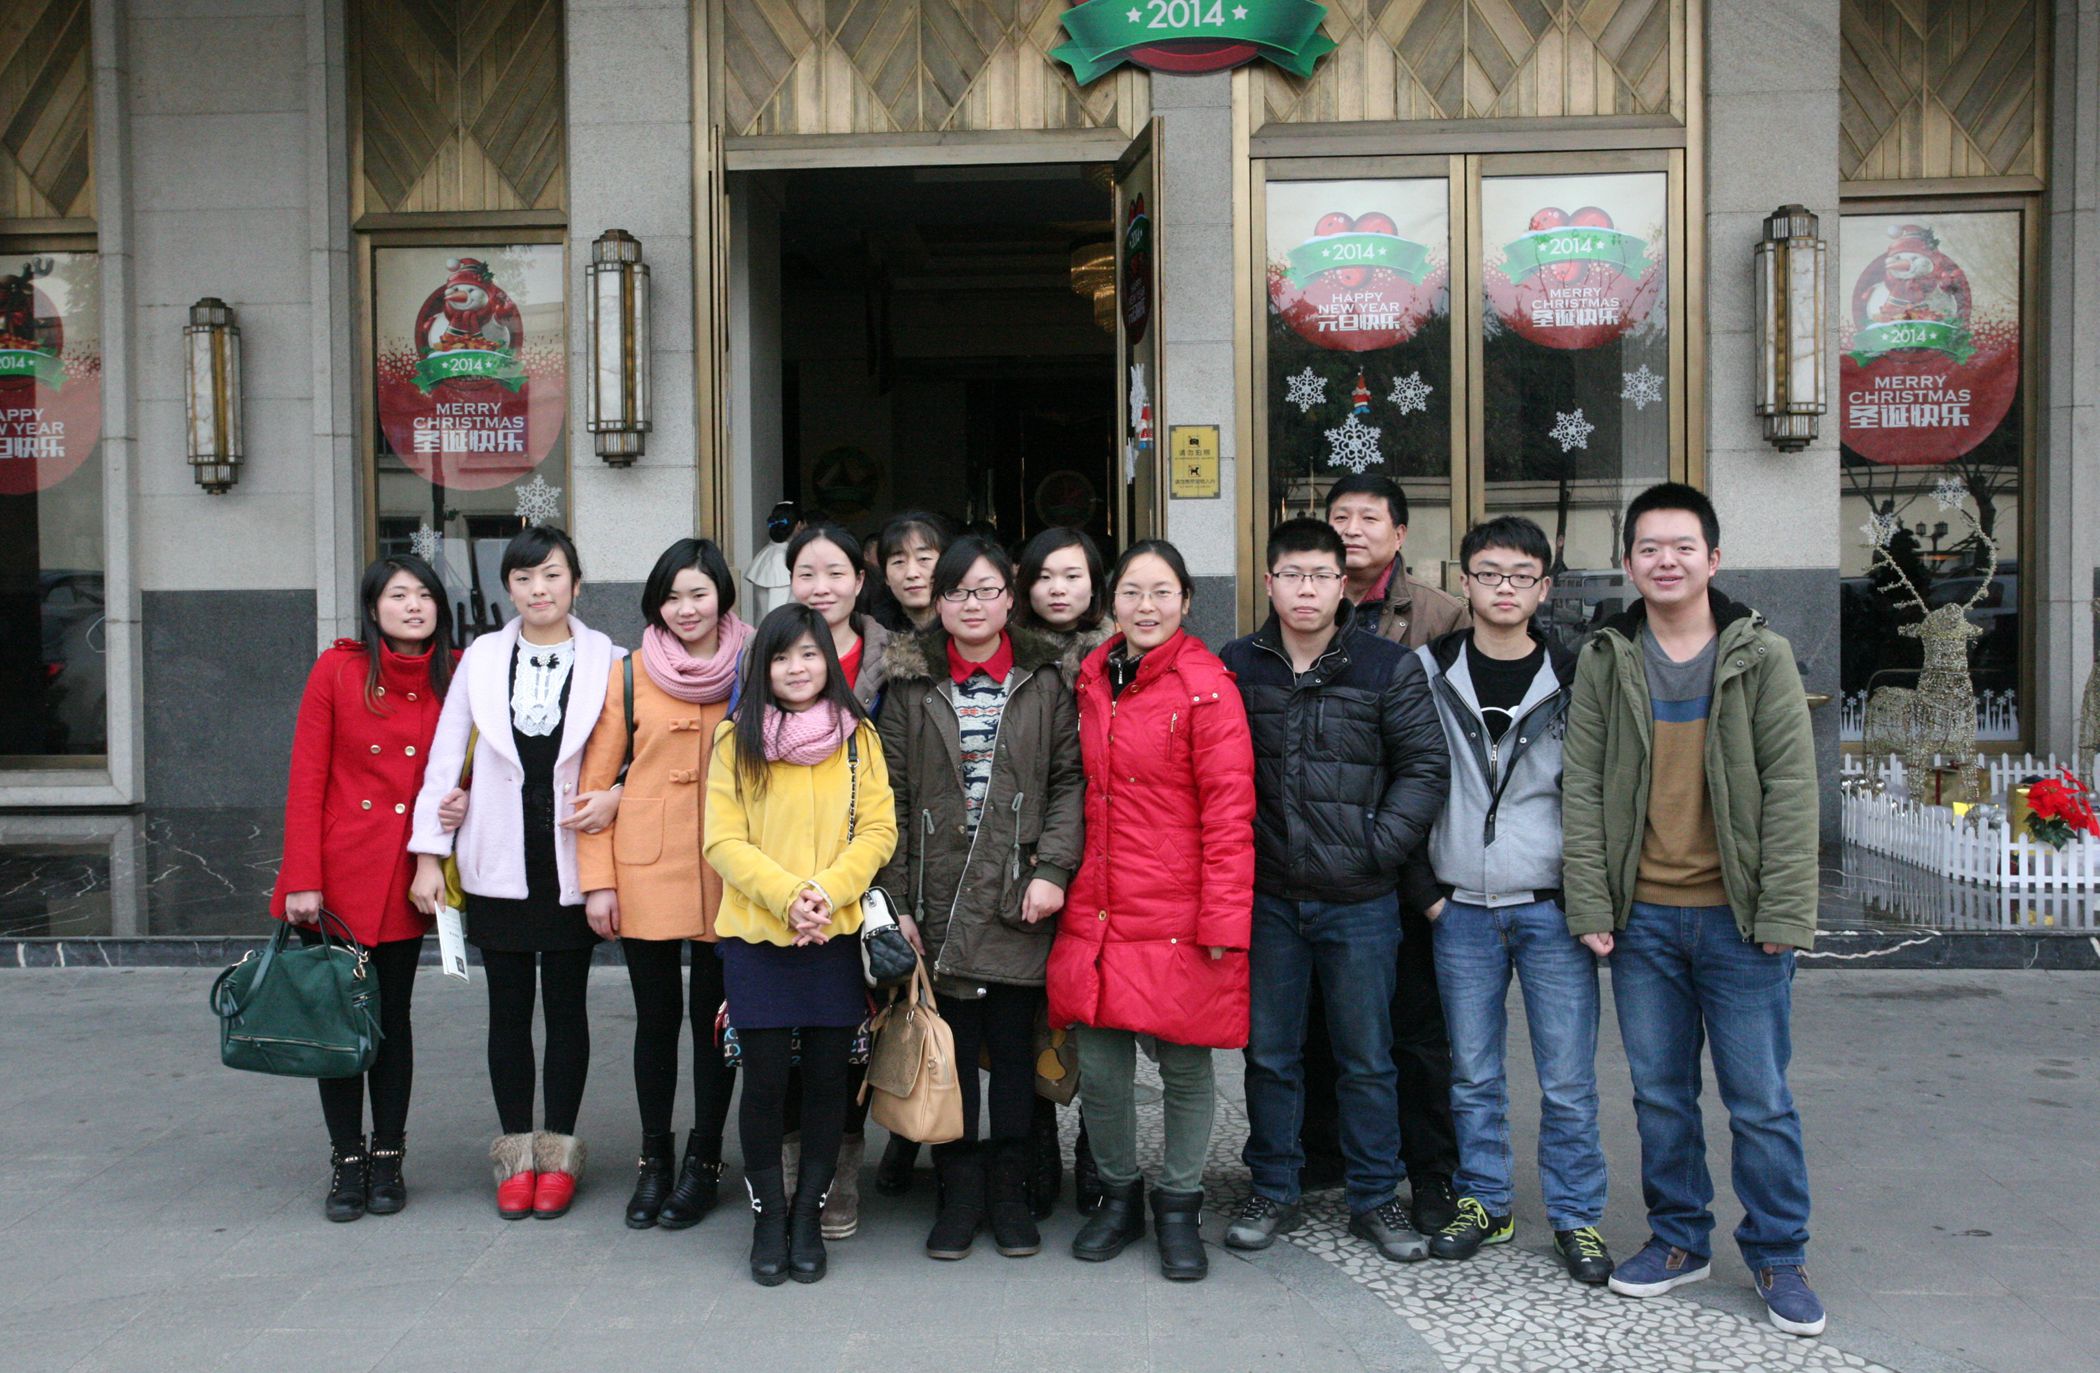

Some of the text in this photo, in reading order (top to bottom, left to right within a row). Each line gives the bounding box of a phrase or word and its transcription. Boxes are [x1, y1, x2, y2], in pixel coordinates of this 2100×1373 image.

[1147, 0, 1225, 28] 2014
[1332, 243, 1375, 260] 2014
[1550, 238, 1593, 255] 2014
[1331, 292, 1383, 303] HAPPY
[1550, 287, 1601, 298] MERRY
[1318, 302, 1400, 314] NEW YEAR
[1531, 297, 1620, 309] CHRISTMAS
[1318, 313, 1400, 332] 元旦快乐
[1532, 308, 1619, 328] 圣诞快乐
[1890, 329, 1927, 344] 2014
[0, 356, 25, 369] 014
[449, 358, 483, 371] 2014
[1874, 375, 1947, 389] MERRY
[1848, 389, 1971, 404] CHRISTMAS
[436, 402, 501, 415] MERRY
[1849, 403, 1970, 428] 圣诞快乐
[13, 421, 64, 435] YEAR
[413, 416, 524, 429] CHRISTMAS
[414, 430, 523, 452] 圣诞快乐
